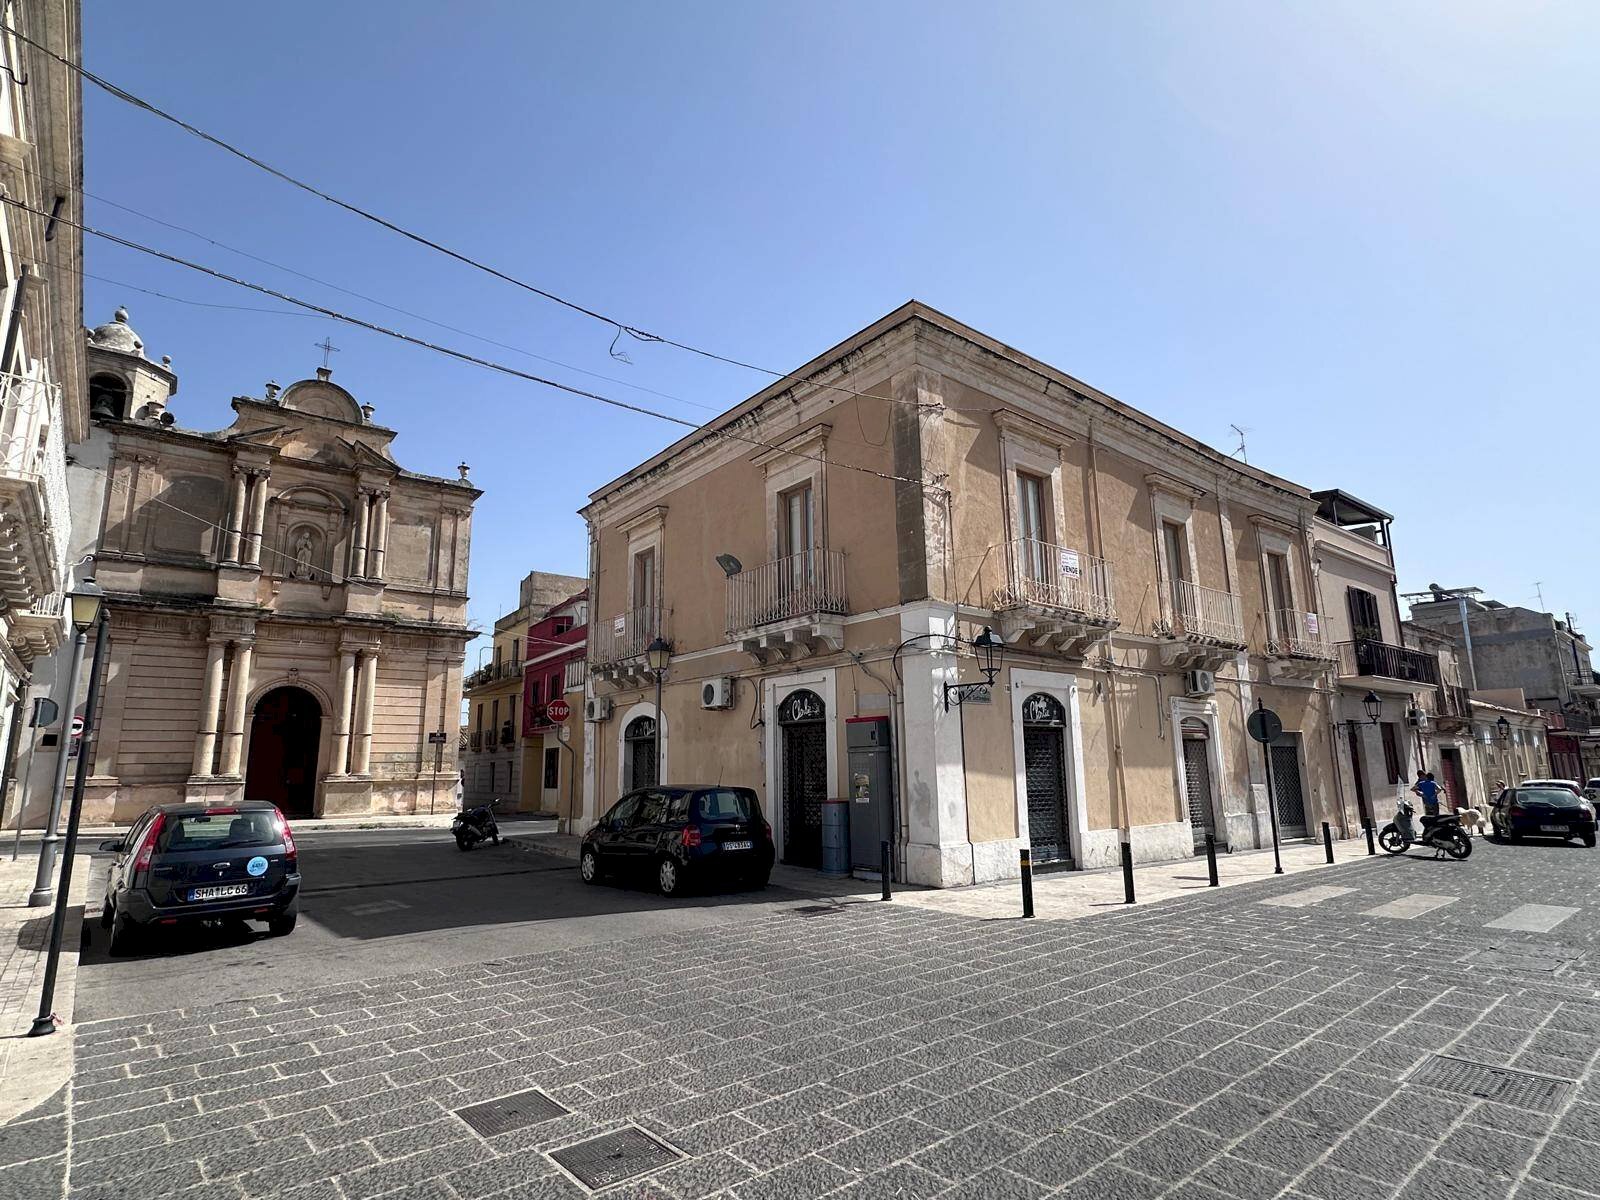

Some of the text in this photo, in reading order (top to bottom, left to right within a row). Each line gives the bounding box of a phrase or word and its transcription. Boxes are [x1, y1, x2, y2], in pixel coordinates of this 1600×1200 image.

[549, 706, 569, 716] STOP
[195, 888, 214, 898] SHA
[235, 884, 247, 894] 66
